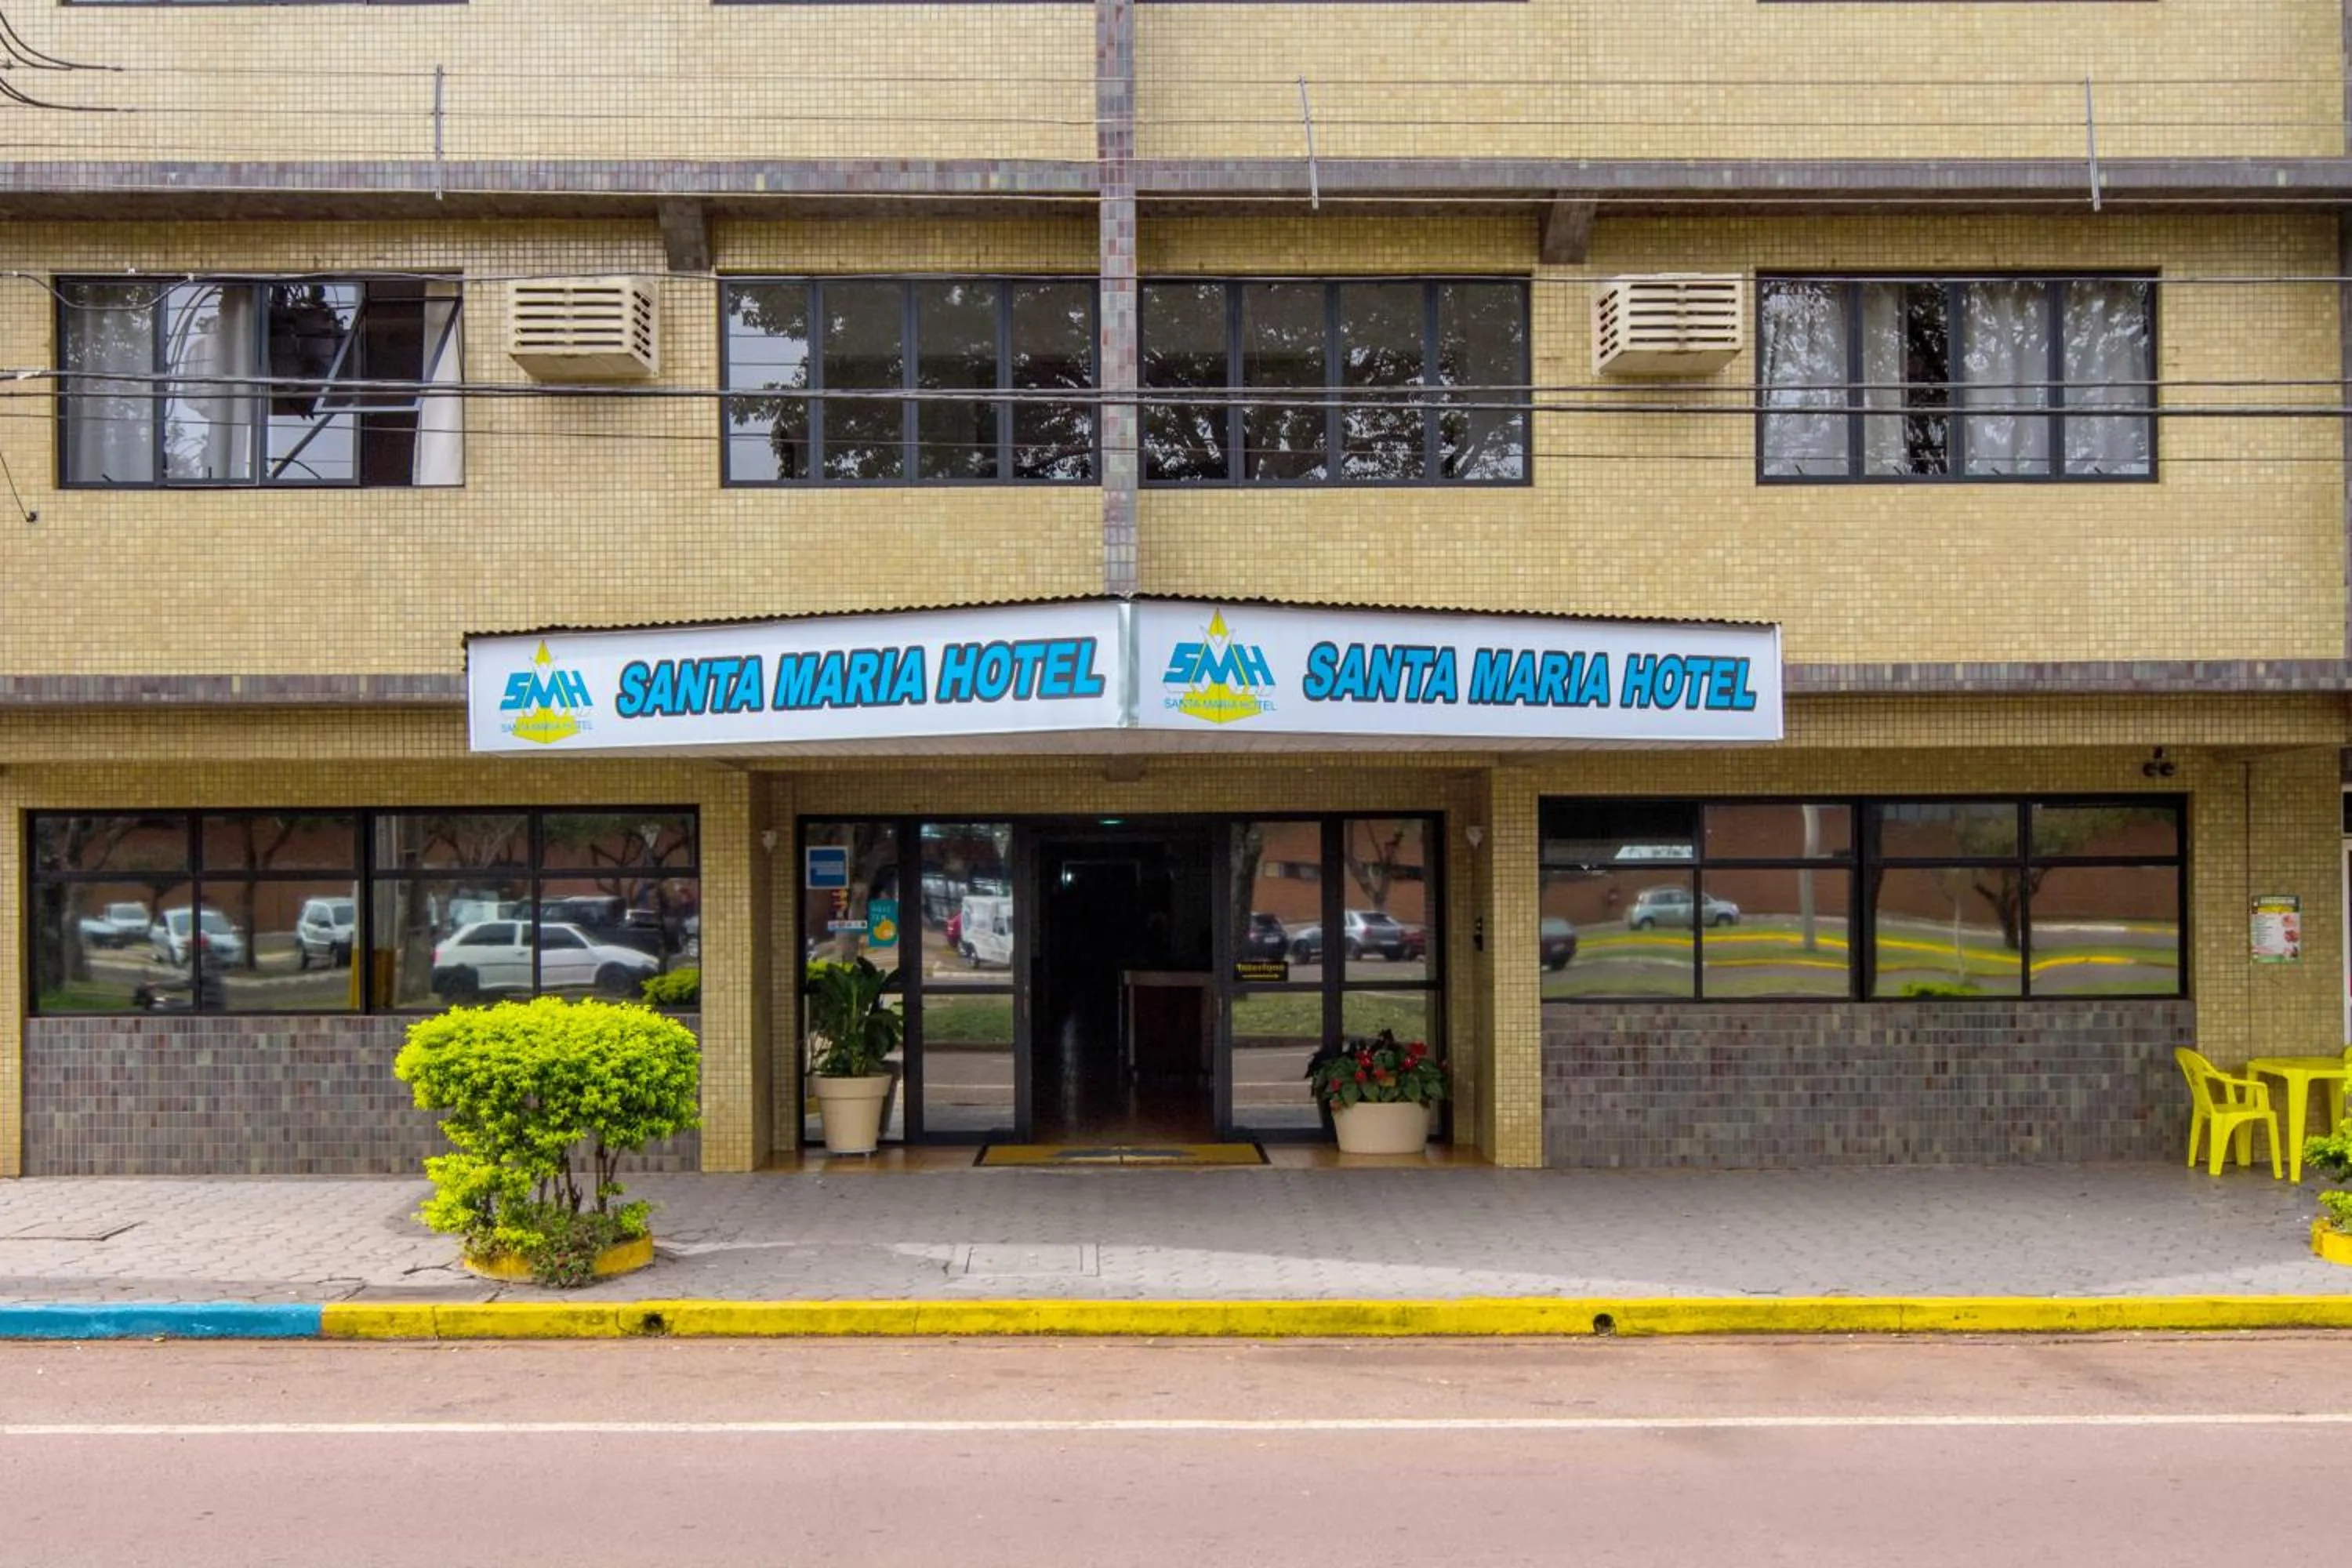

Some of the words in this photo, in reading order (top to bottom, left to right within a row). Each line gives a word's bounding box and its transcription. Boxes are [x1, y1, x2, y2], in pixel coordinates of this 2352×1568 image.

[500, 670, 593, 710] SMH
[615, 655, 765, 718] SANTA
[771, 645, 928, 711] MARIA
[935, 637, 1105, 702] HOTEL
[1163, 643, 1276, 686] SMH
[1302, 642, 1458, 703] SANTA
[1467, 648, 1612, 706] MARIA
[1620, 653, 1758, 710] HOTEL
